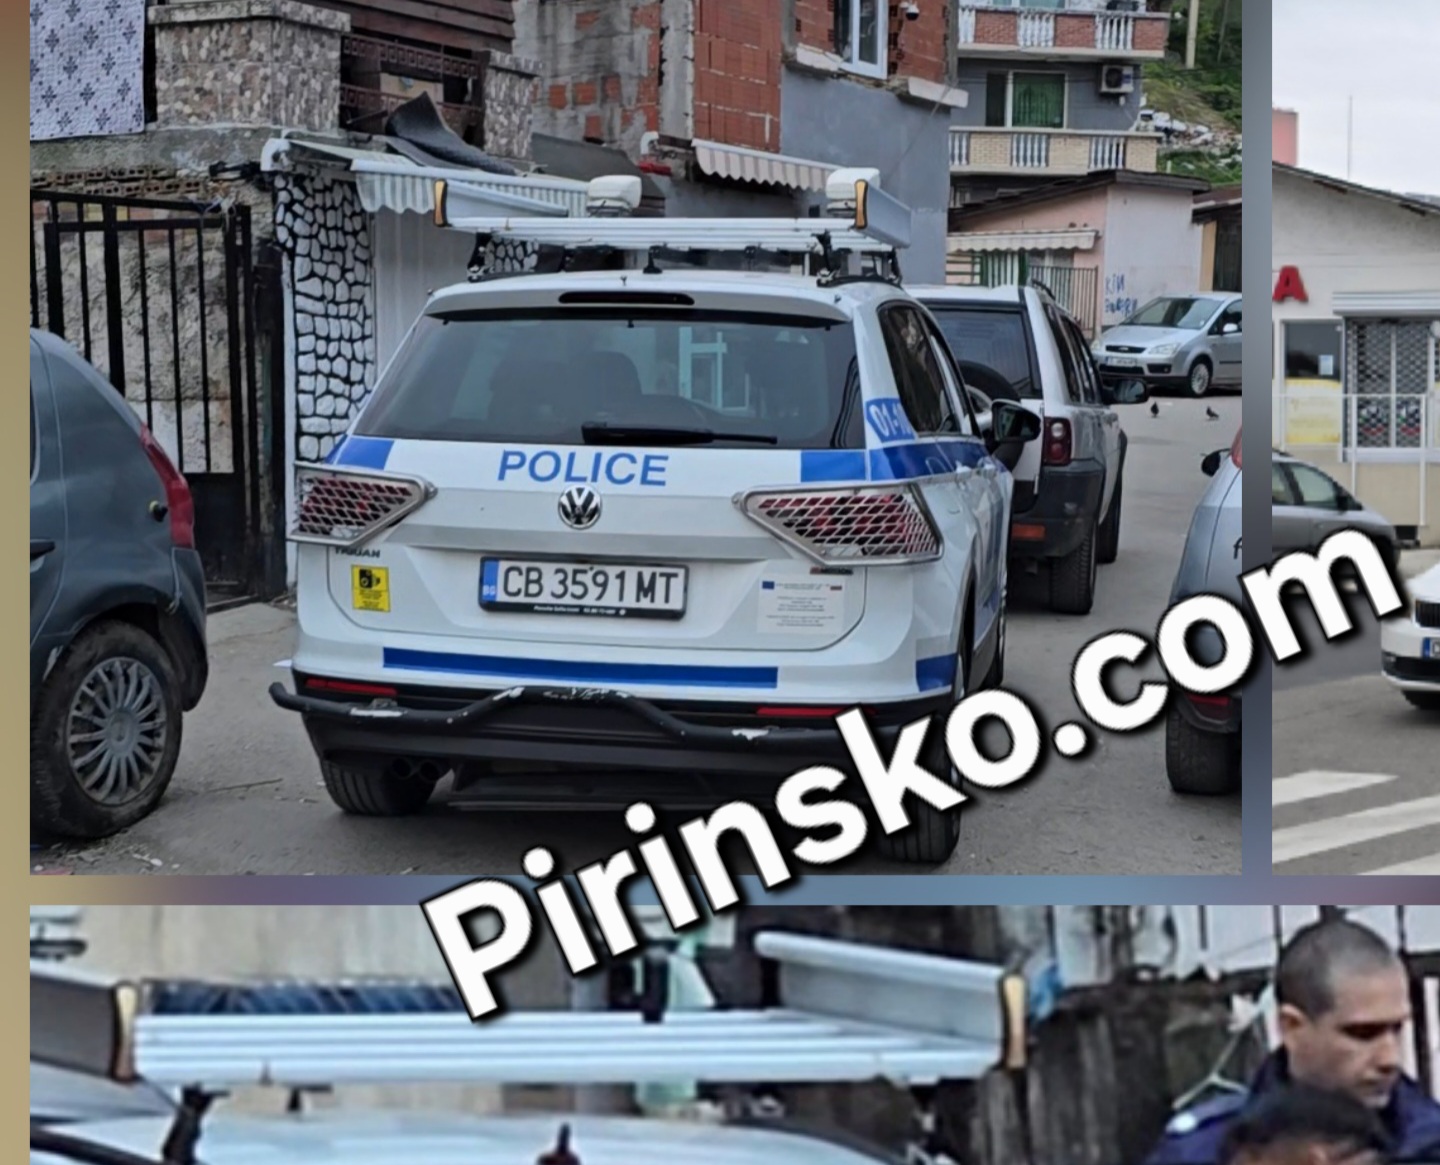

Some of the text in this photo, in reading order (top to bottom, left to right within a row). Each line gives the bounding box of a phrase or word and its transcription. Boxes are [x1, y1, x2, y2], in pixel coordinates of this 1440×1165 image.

[498, 450, 670, 486] POLICE
[503, 566, 679, 604] CB 3591 MT
